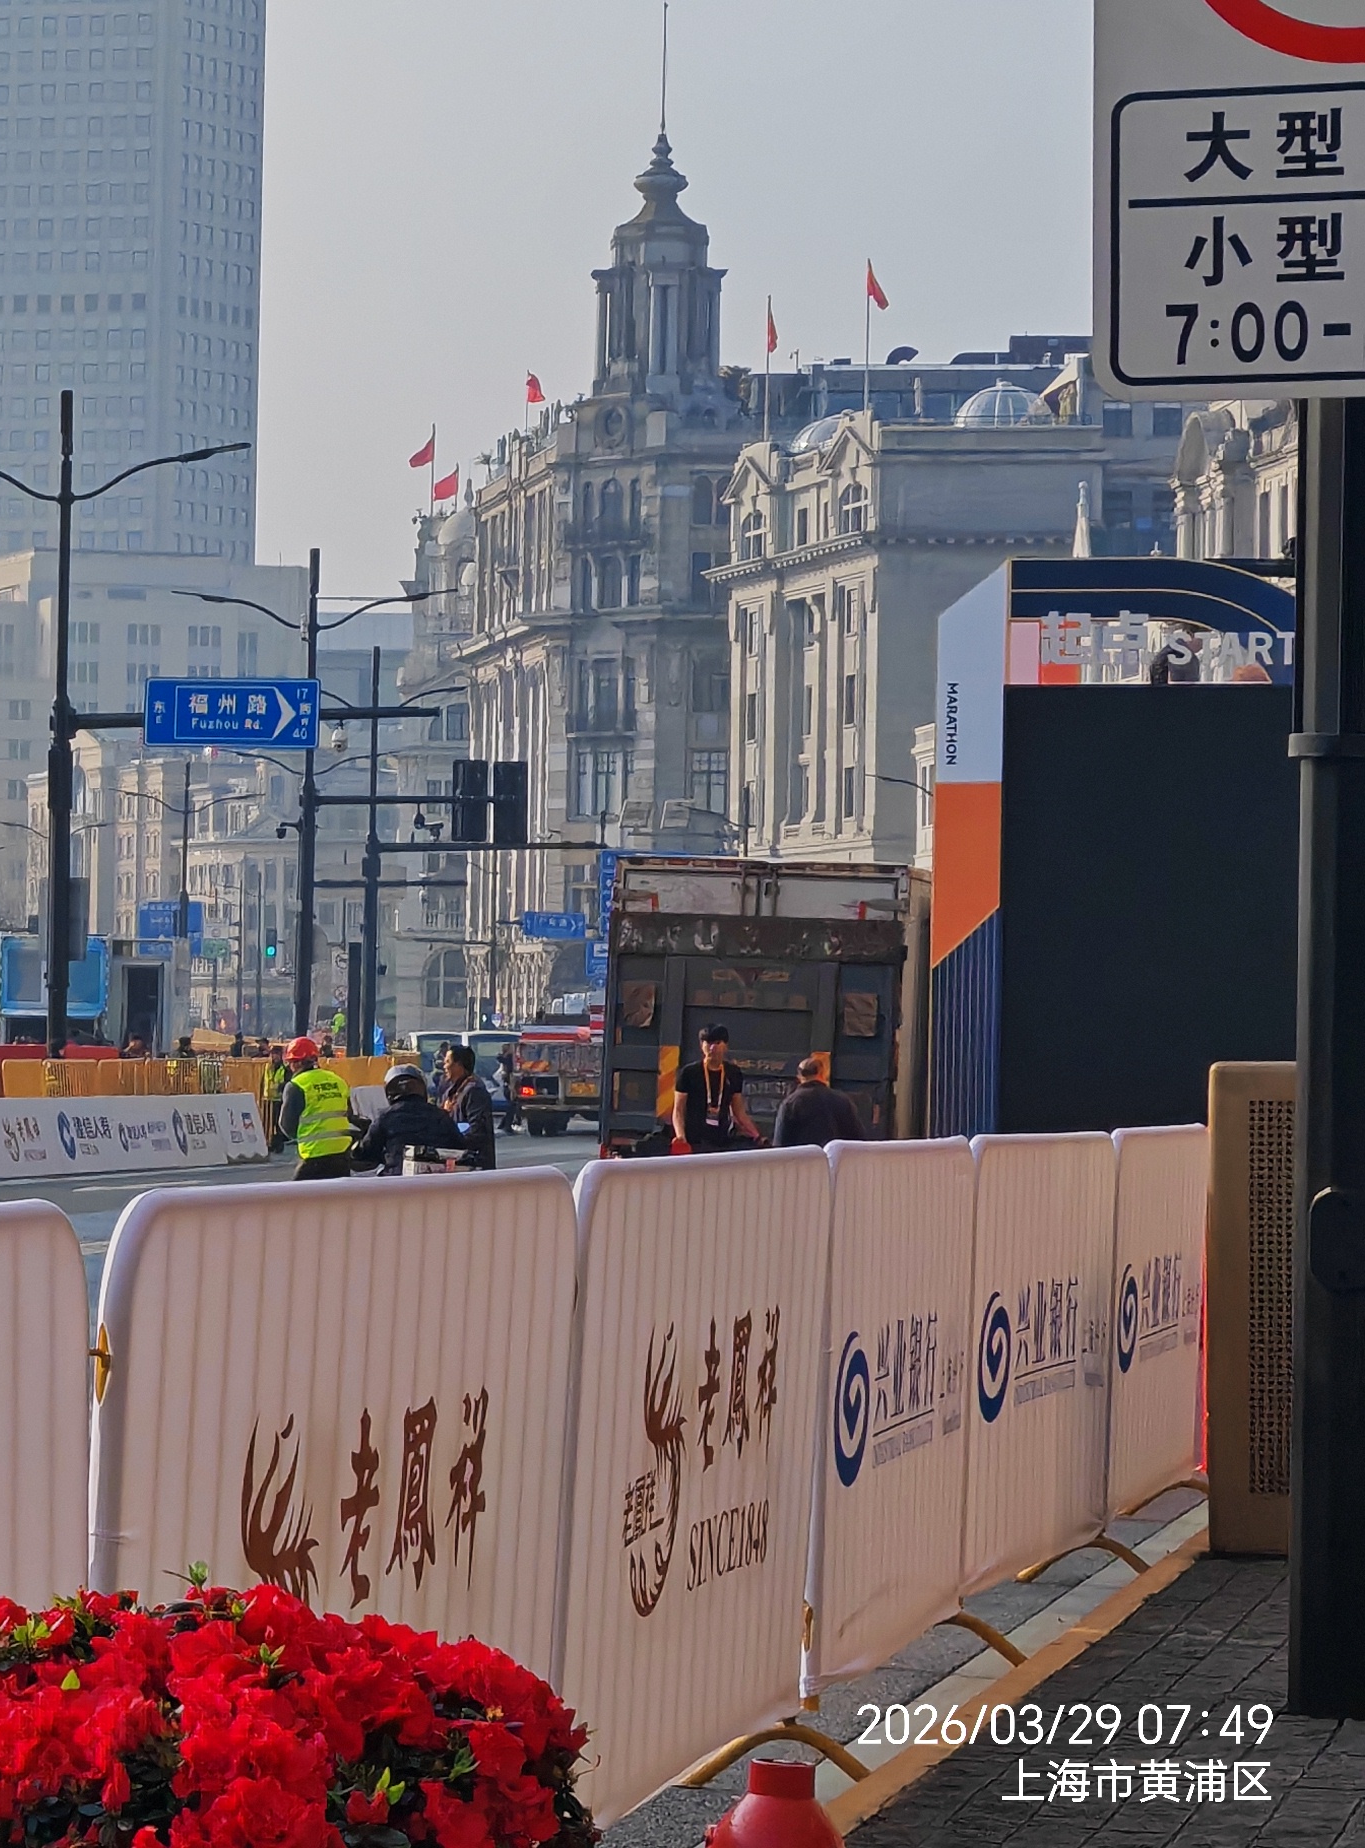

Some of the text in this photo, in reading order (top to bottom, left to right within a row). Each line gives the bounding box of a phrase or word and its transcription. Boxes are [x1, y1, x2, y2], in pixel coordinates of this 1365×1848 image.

[1183, 107, 1345, 183] 大型
[1183, 212, 1345, 287] 小型
[1040, 610, 1295, 667] 起点 START
[189, 694, 267, 714] 福州路
[191, 717, 264, 730] Fuzhou Rd.
[296, 688, 308, 700] 17
[945, 682, 959, 766] MARATHON
[292, 728, 308, 740] 40
[1015, 1276, 1079, 1371] 兴业银行
[873, 1310, 938, 1428] 兴业银行
